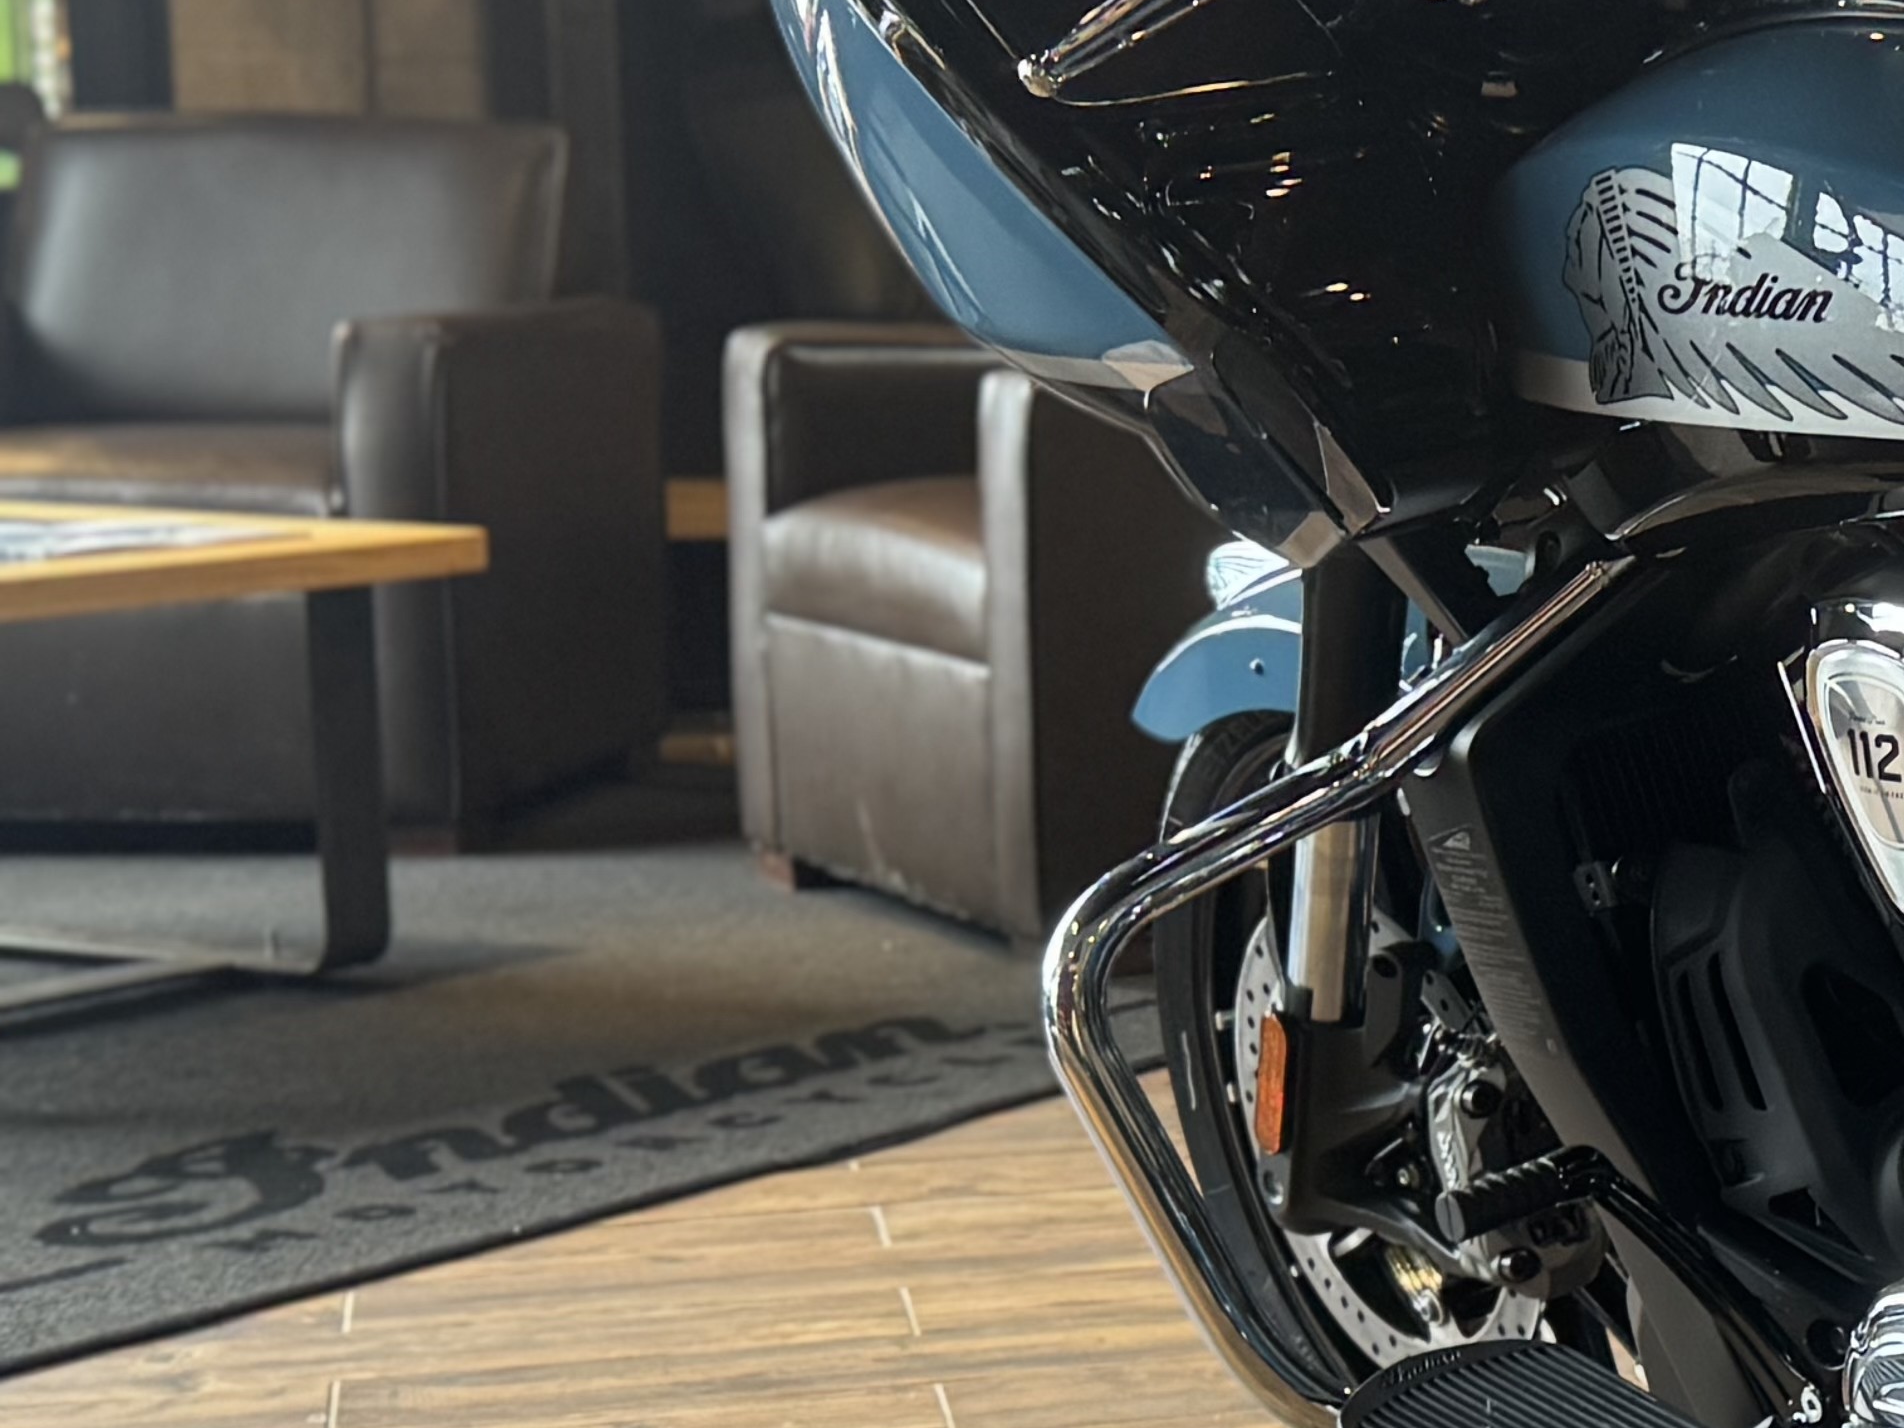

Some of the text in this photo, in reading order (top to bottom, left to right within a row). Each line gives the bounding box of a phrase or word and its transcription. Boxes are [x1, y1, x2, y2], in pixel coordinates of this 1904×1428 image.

[1656, 262, 1835, 324] Indian
[1847, 728, 1903, 783] 112
[32, 1014, 988, 1248] Indian
